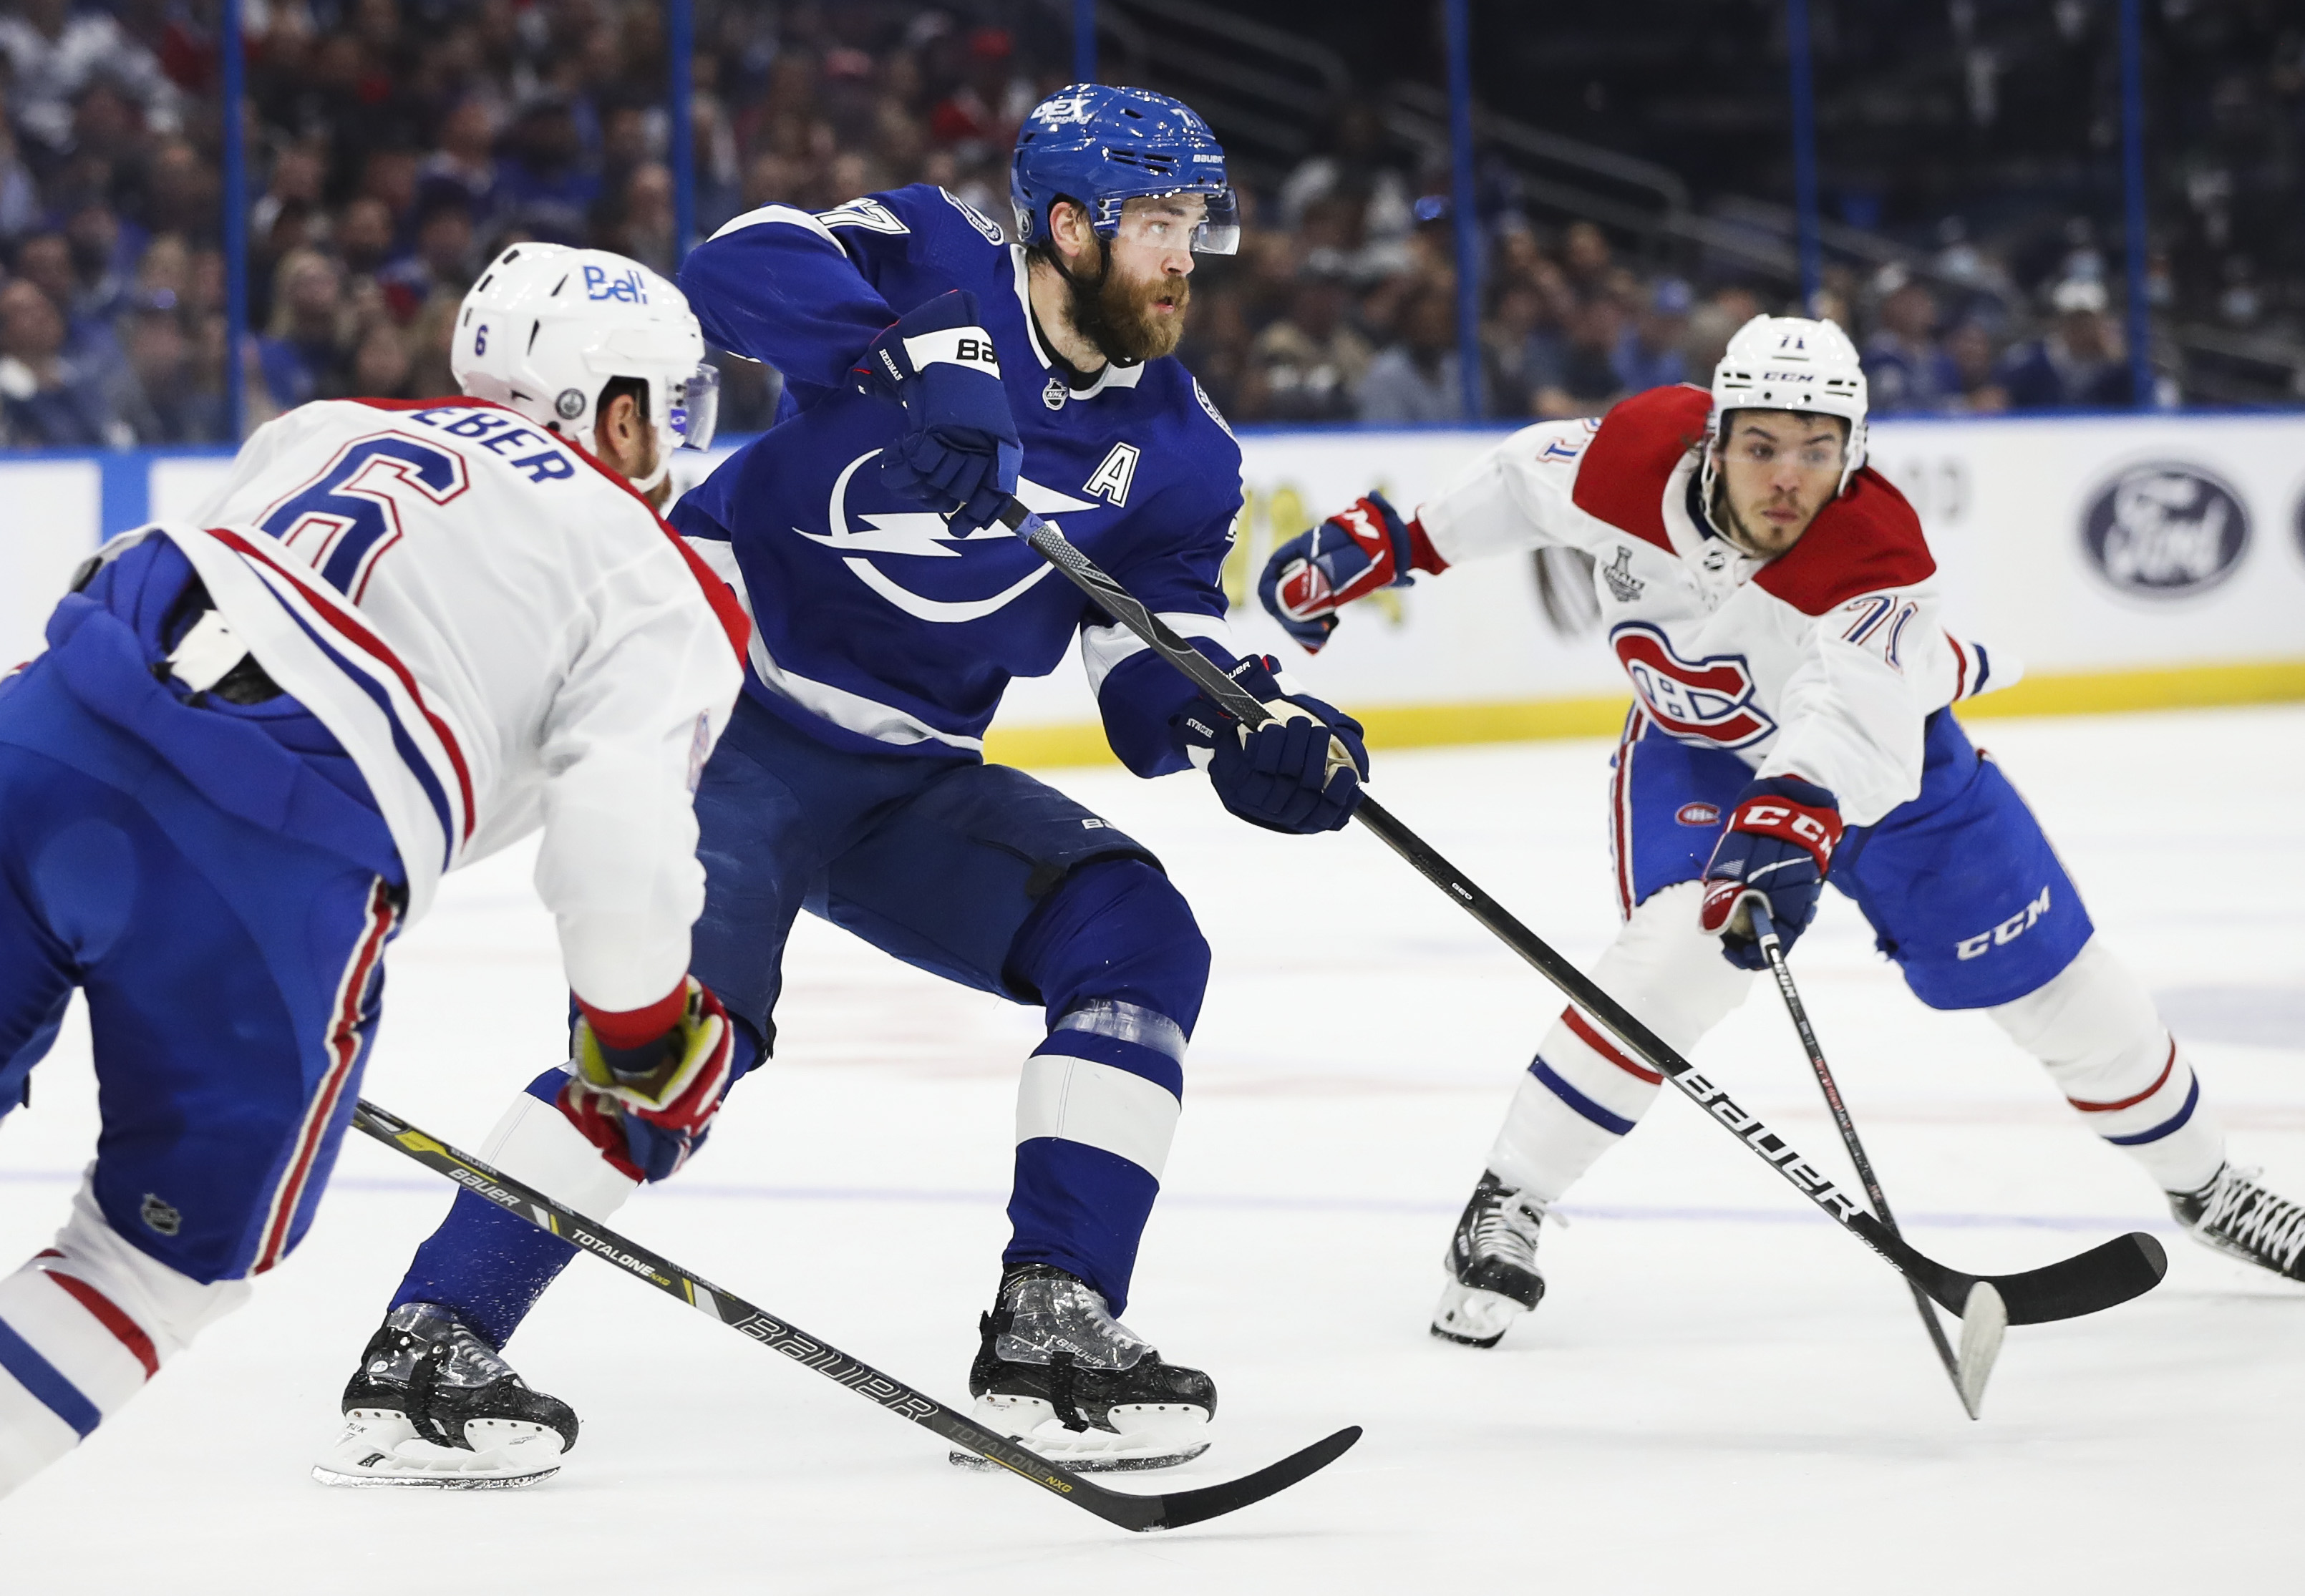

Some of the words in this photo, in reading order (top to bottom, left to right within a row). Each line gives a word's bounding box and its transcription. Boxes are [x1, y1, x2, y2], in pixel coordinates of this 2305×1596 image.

[1030, 98, 1091, 119] DEX
[583, 266, 648, 306] Bell
[475, 325, 489, 356] 6
[1775, 334, 1805, 350] 71
[879, 349, 903, 381] HEDMAN
[1764, 372, 1815, 382] CCM
[409, 406, 574, 484] EBER
[1082, 442, 1141, 508] A
[251, 429, 470, 606] 6
[1841, 595, 1918, 676] 71
[1186, 718, 1214, 738] HEDMAN
[1743, 805, 1833, 862] CCM
[1452, 882, 1472, 900] GEO
[1956, 885, 2050, 960] CCM
[1044, 1474, 1073, 1493] NXG
